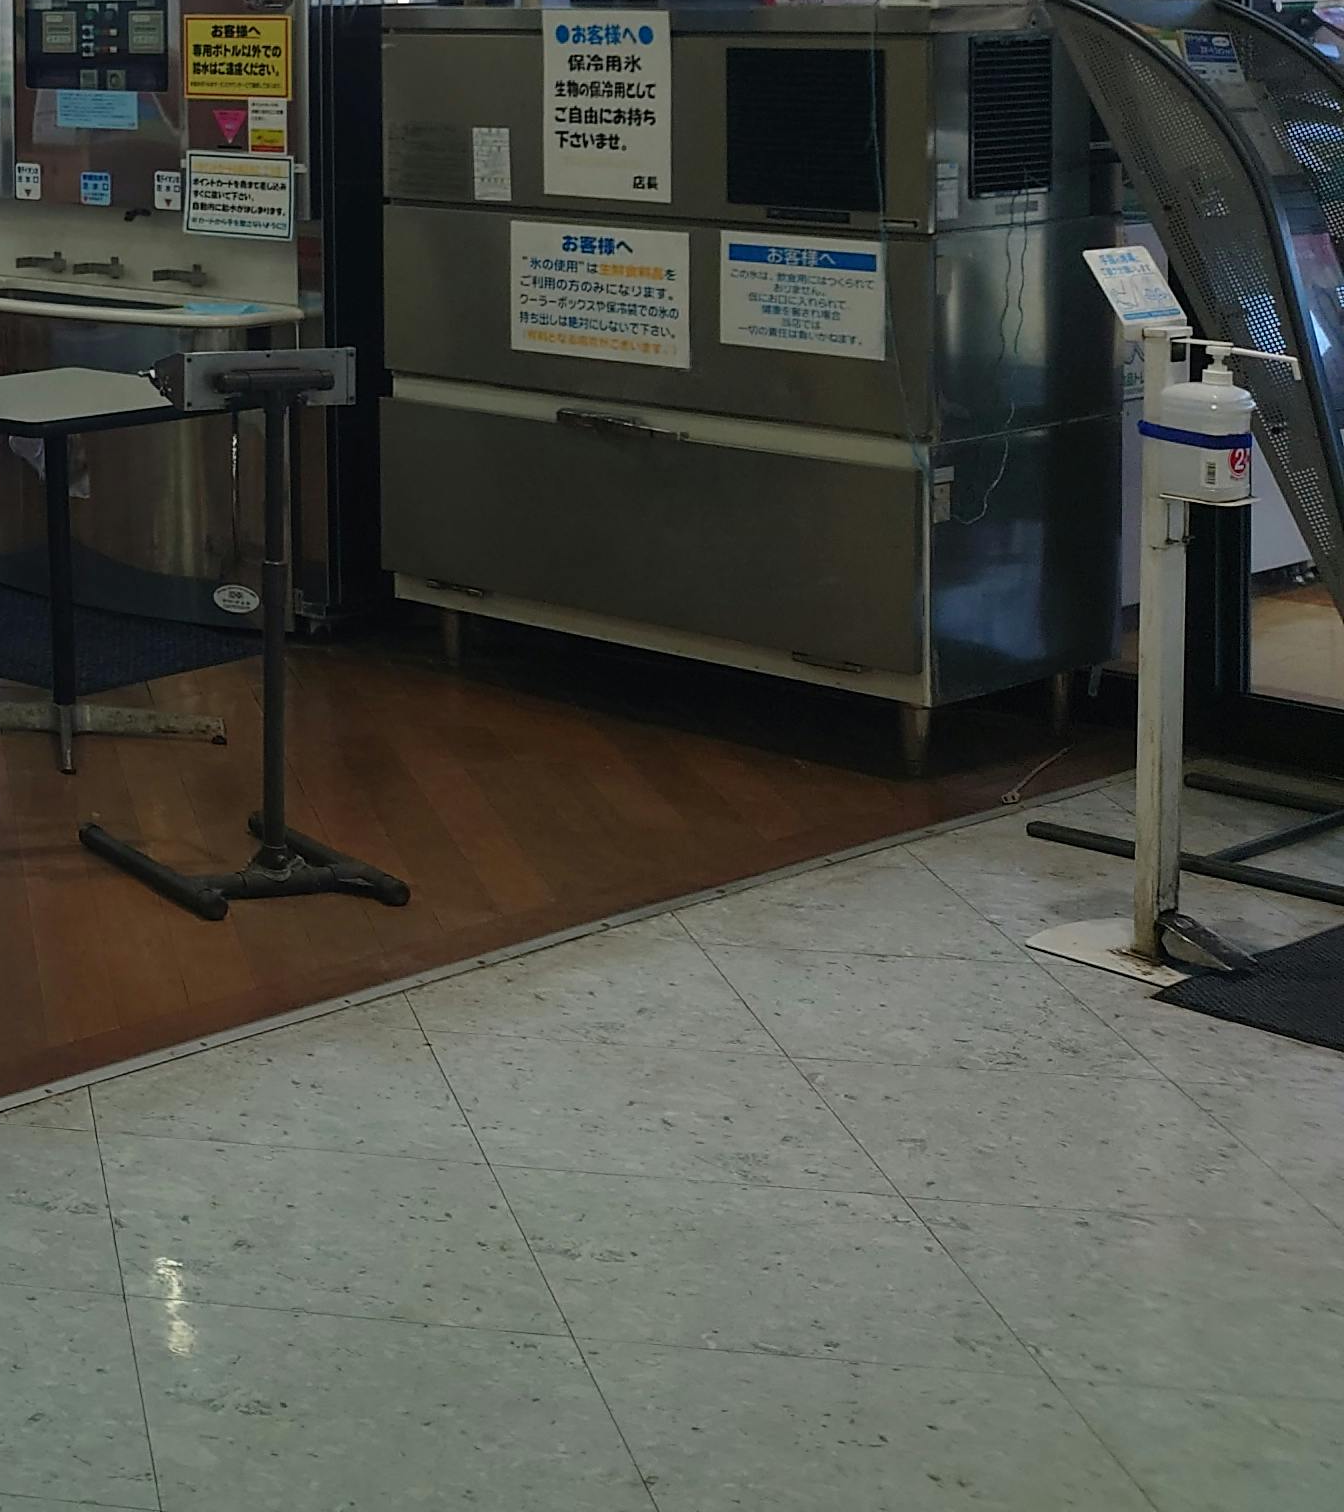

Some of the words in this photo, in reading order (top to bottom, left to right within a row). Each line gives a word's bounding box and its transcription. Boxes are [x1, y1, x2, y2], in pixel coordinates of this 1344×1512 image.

[211, 25, 261, 38] お客様へ
[571, 24, 637, 45] お客様へ
[193, 44, 282, 58] 専用ボトル以外での
[193, 62, 279, 76] 給水はご遠慮ください。
[568, 54, 642, 72] 保冷用氷
[555, 80, 656, 99] 生物の保冷用として
[555, 106, 656, 126] ご自由にお持ち
[555, 130, 627, 151] 下さいませ。
[633, 176, 659, 190] 店長
[562, 235, 633, 255] お客様へ
[768, 248, 836, 267] お客様へ
[520, 275, 674, 301] ご利用の方のみになります。
[520, 293, 679, 320] クーラーボックスや保冷袋での氷の
[519, 311, 676, 339] 持ち出しは絶対にしないで下さい。
